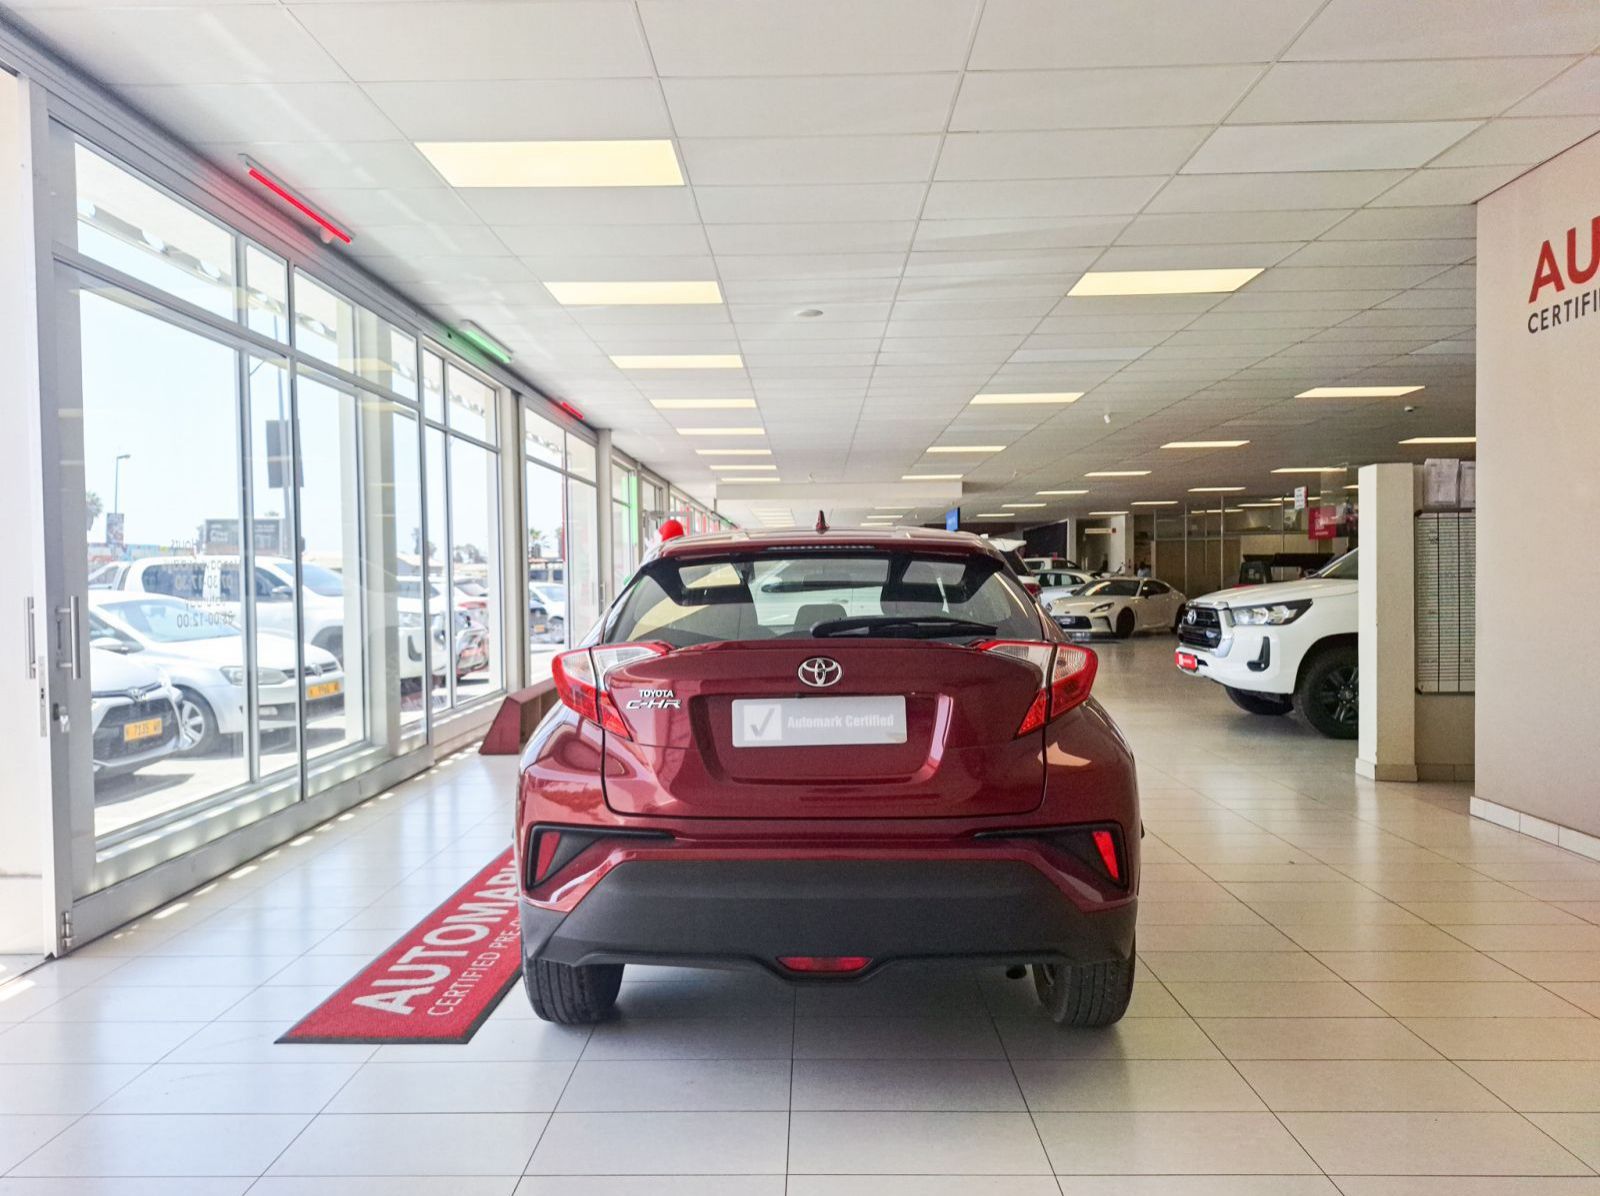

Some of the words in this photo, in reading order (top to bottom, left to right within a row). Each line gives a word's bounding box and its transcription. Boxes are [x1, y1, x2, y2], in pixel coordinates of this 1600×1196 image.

[1528, 287, 1600, 334] CERTIFI
[638, 689, 674, 698] TOYOTA
[626, 699, 682, 709] C-HR
[787, 715, 842, 729] Automark
[845, 713, 895, 728] Certified
[427, 951, 501, 1016] CERTIFIED
